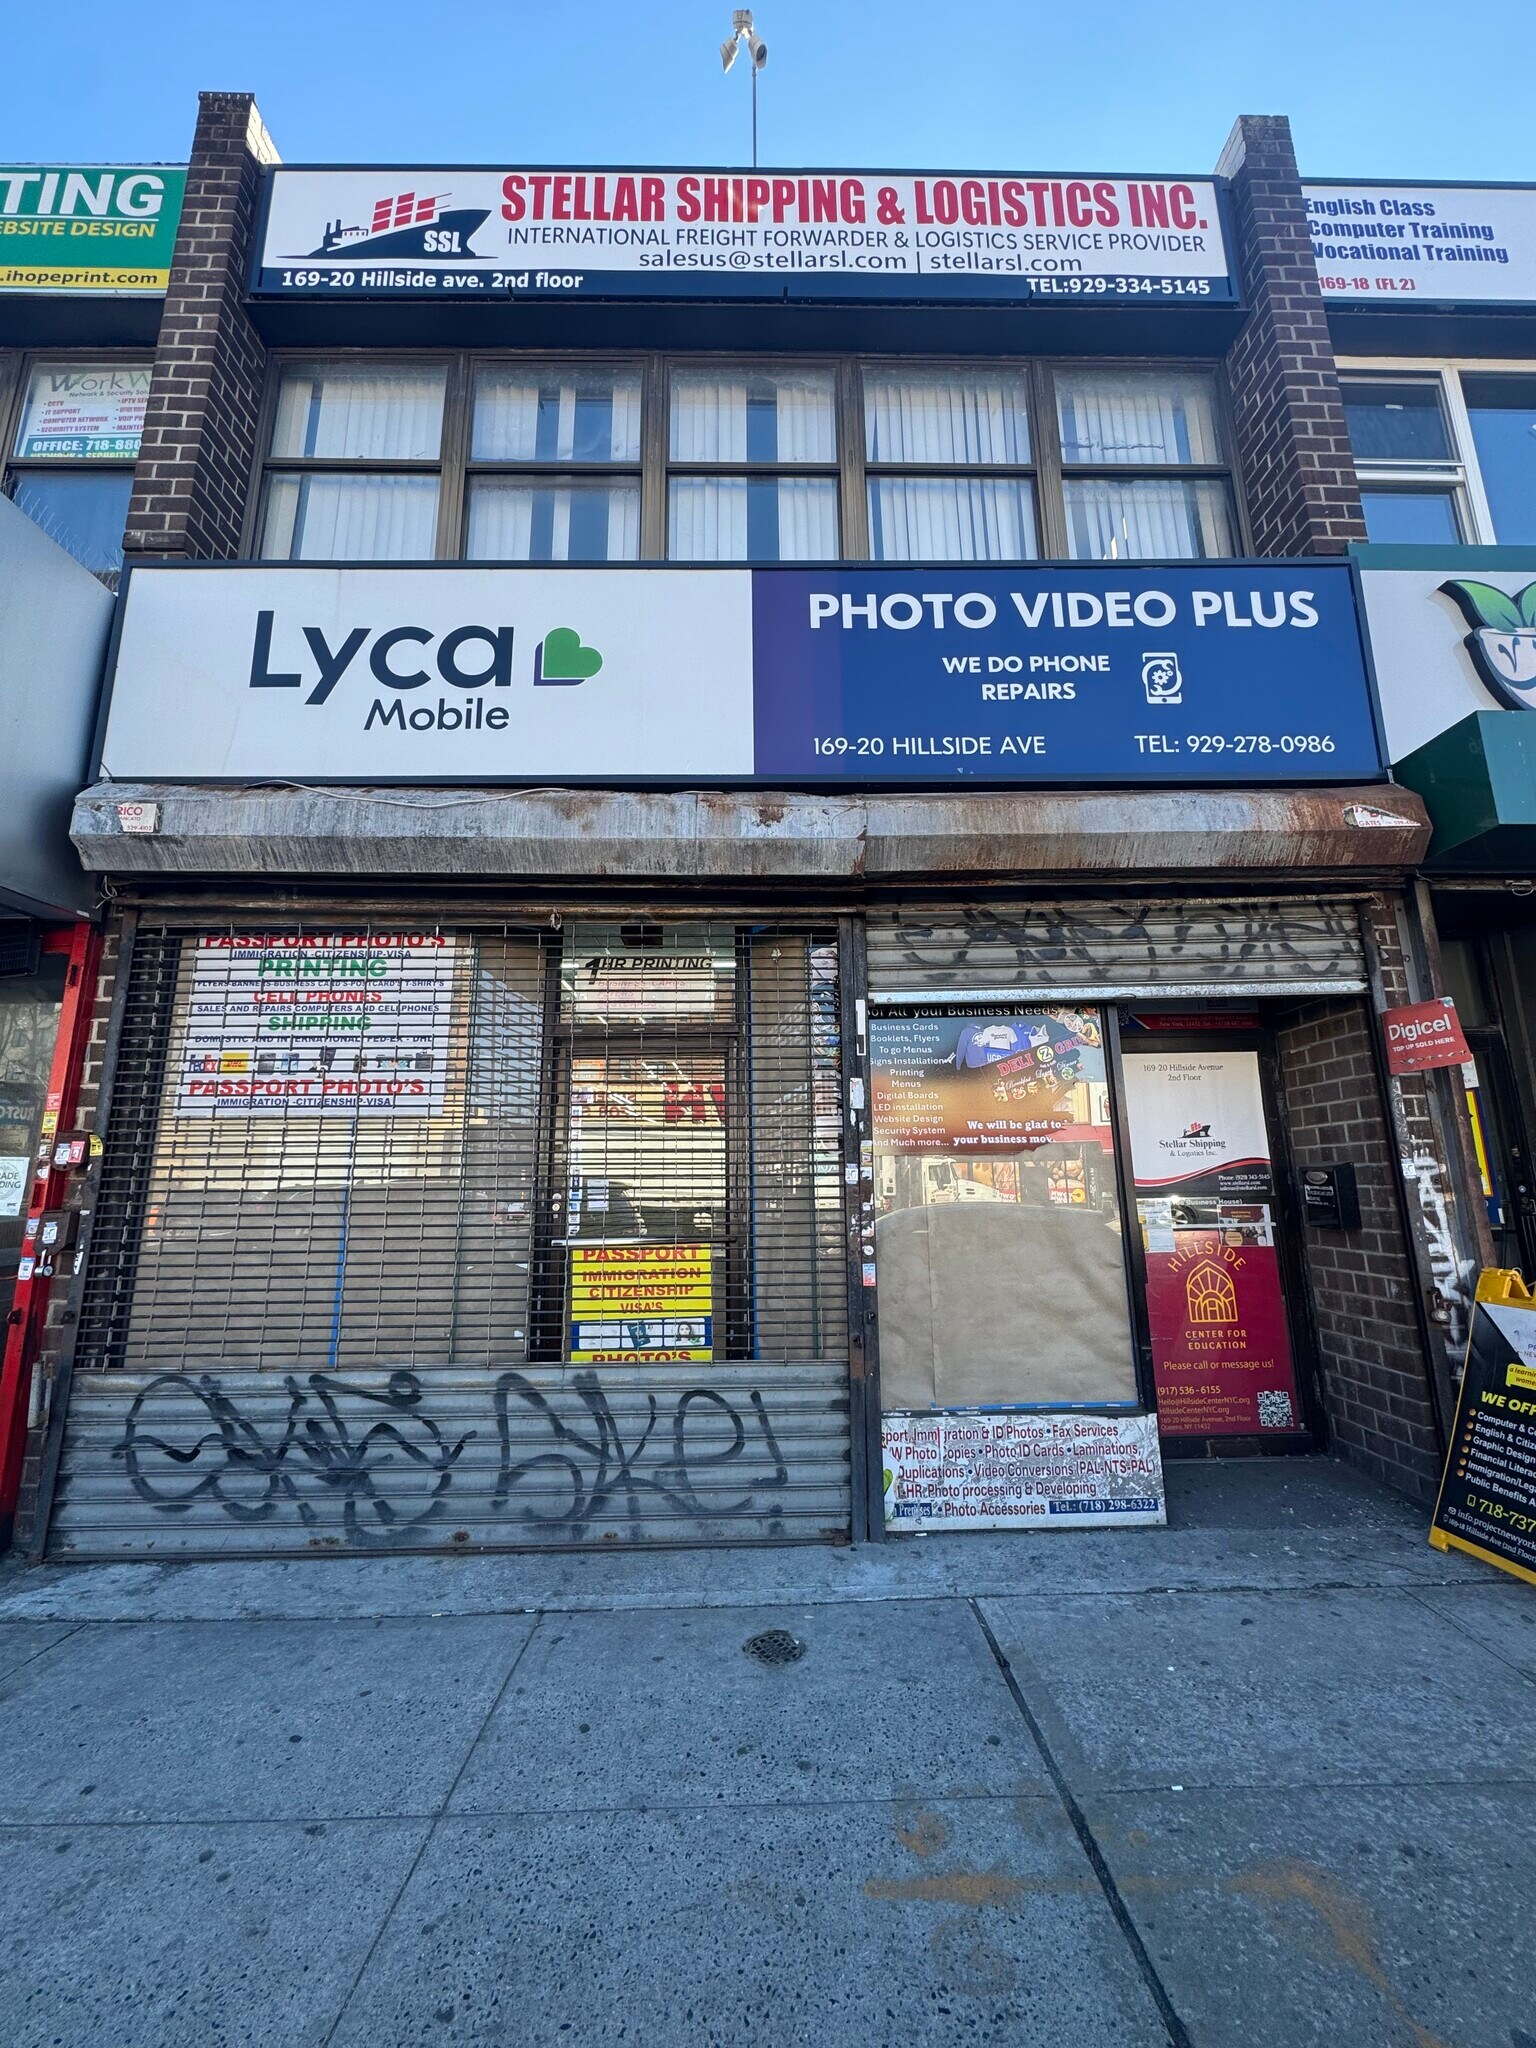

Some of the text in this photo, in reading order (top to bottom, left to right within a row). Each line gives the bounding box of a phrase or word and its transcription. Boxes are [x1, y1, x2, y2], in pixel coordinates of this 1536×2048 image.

[0, 173, 164, 216] TING
[502, 175, 1208, 230] STELLAR SHIPPING & LOGISTICS INC.
[1303, 198, 1436, 217] English Class
[70, 222, 156, 238] DESIGN
[1307, 220, 1495, 241] Computer Training
[424, 230, 462, 254] SSL
[508, 227, 1206, 253] INTERNATIONAL FREIGHT FORWARDER & LOGISTICS SERVICE PROVIDER
[639, 249, 1082, 273] salesus@stellarsl.com stellarsl.com
[1422, 245, 1509, 264] Training
[282, 271, 583, 289] 169-20 Hillside ave. 2nd floor
[1026, 277, 1210, 295] TEL:929-334-5145
[1319, 276, 1370, 290] 169-18
[32, 440, 82, 452] OFFICE:
[809, 590, 1320, 630] PHOTO VIDEO PLUS
[249, 609, 515, 705] Lyca
[942, 655, 1111, 674] WE DO PHONE
[981, 682, 1077, 701] REPAIRS
[363, 697, 510, 731] Mobile
[813, 736, 1047, 756] 169-20 HILLSIDE AVE
[1134, 735, 1336, 755] TEL: 929-278-0986
[204, 931, 446, 949] PASSPORT PHOTO'S
[258, 958, 388, 977] PRINTING
[631, 957, 713, 969] PRINTING
[253, 991, 383, 1004] CELL PHONES
[197, 1004, 292, 1013] SALES REPAIRS
[914, 1004, 1058, 1019] your Business Needs
[267, 1016, 372, 1032] SHIPPING
[871, 1023, 939, 1031] Business Cards
[1388, 1013, 1452, 1042] Digicel
[871, 1034, 940, 1044] Booklets, Flyers
[1415, 1040, 1434, 1049] SOLD
[1434, 1036, 1456, 1045] HERE
[879, 1046, 933, 1056] To go Menus
[870, 1057, 945, 1066] Signs Installation
[996, 1053, 1035, 1076] DELI
[1142, 1063, 1224, 1072] 169-20 Hillside Avenue
[889, 1068, 925, 1077] Printing
[1168, 1073, 1202, 1082] 2nd Floor
[190, 1078, 425, 1096] PASSPORT PHOTO'S
[217, 1098, 289, 1107] IMMIGRATION
[877, 1092, 906, 1100] Digital
[873, 1103, 944, 1111] LED installation
[874, 1115, 944, 1124] Website Design
[967, 1120, 1062, 1131] We will be glad to
[873, 1127, 946, 1136] Security System
[890, 1138, 916, 1146] Much
[953, 1134, 1028, 1146] your business
[1158, 1139, 1226, 1150] Stellar Shipping
[1177, 1150, 1205, 1158] Logistics
[582, 1244, 702, 1261] PASSPORT
[1167, 1240, 1247, 1273] HILLSIDE
[582, 1267, 702, 1282] IMMIGRATION
[589, 1284, 695, 1298] CITIZENSHIP
[620, 1301, 664, 1314] VISA'S
[1185, 1329, 1247, 1339] CENTER FOR
[1188, 1341, 1247, 1350] EDUCATION
[1163, 1360, 1193, 1370] Please
[1193, 1360, 1209, 1370] call
[1221, 1360, 1260, 1370] message
[1261, 1359, 1274, 1368] us!
[1157, 1385, 1221, 1396] (917) 536 6155
[1481, 1391, 1507, 1408] WE
[1477, 1411, 1526, 1433] Computer &
[981, 1423, 1119, 1439] & ID Photos Fax Services
[1475, 1423, 1514, 1443] English &
[905, 1442, 1141, 1460] Photo Photo ID Cards Laminations,
[1470, 1448, 1507, 1468] Financial
[1472, 1436, 1536, 1464] Graphic Design
[974, 1459, 1156, 1477] Video Conversions (PAL-NTS-PAL)
[927, 1481, 1097, 1500] Photo processing & Developing
[1465, 1472, 1528, 1505] Public Benefits
[944, 1498, 1155, 1517] Photo Accessories Tel.: (718) 298-6322
